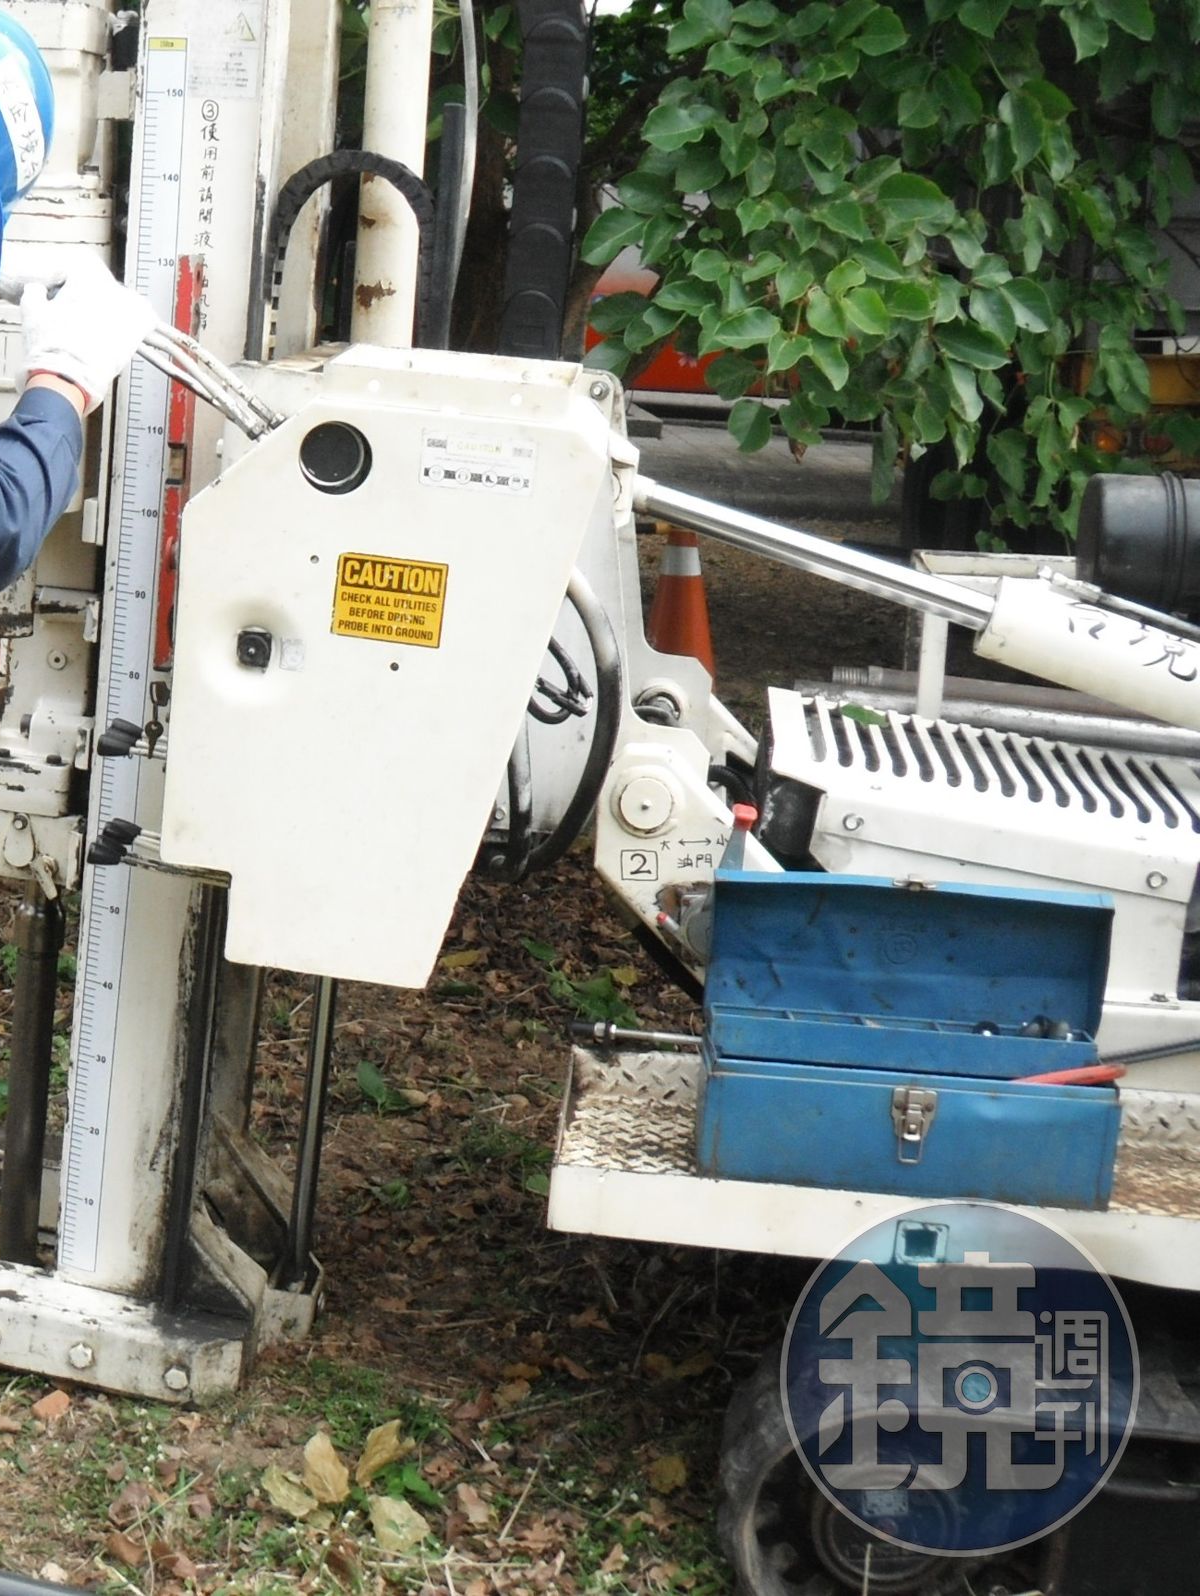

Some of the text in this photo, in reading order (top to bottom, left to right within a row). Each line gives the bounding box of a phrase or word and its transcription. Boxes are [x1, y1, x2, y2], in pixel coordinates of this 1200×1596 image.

[166, 88, 184, 98] 150
[162, 173, 180, 182] 140
[157, 258, 175, 267] 130
[147, 425, 164, 435] 110
[141, 508, 158, 518] 100
[344, 560, 440, 595] CAUTION
[134, 590, 146, 599] 90
[341, 591, 437, 613] CHECK ALL UTILITIES
[348, 606, 385, 620] BEFORE
[338, 619, 433, 641] PROBE INTO GROUND
[128, 671, 140, 680] 80
[629, 852, 652, 875] 2
[676, 853, 713, 869] 油門
[109, 905, 120, 915] 50
[102, 981, 113, 990] 40
[95, 1054, 107, 1064] 30
[89, 1127, 100, 1136] 20
[84, 1197, 94, 1206] 10
